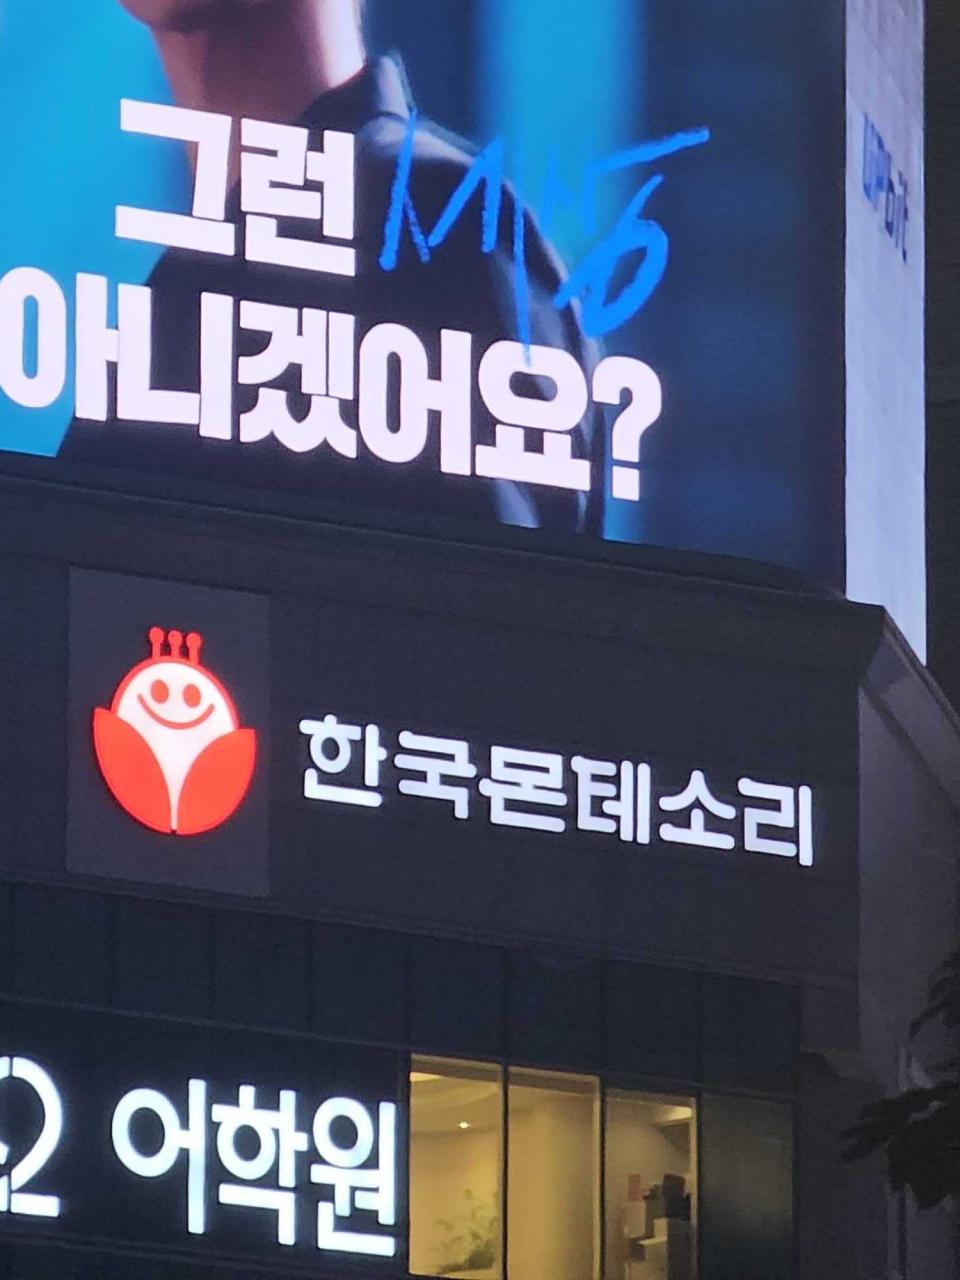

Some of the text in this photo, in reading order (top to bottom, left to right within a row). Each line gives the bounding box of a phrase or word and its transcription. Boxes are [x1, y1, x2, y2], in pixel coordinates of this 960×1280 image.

[114, 97, 357, 277] 그런
[298, 713, 816, 868] 한국몬테소리
[111, 1078, 397, 1258] 어학원
